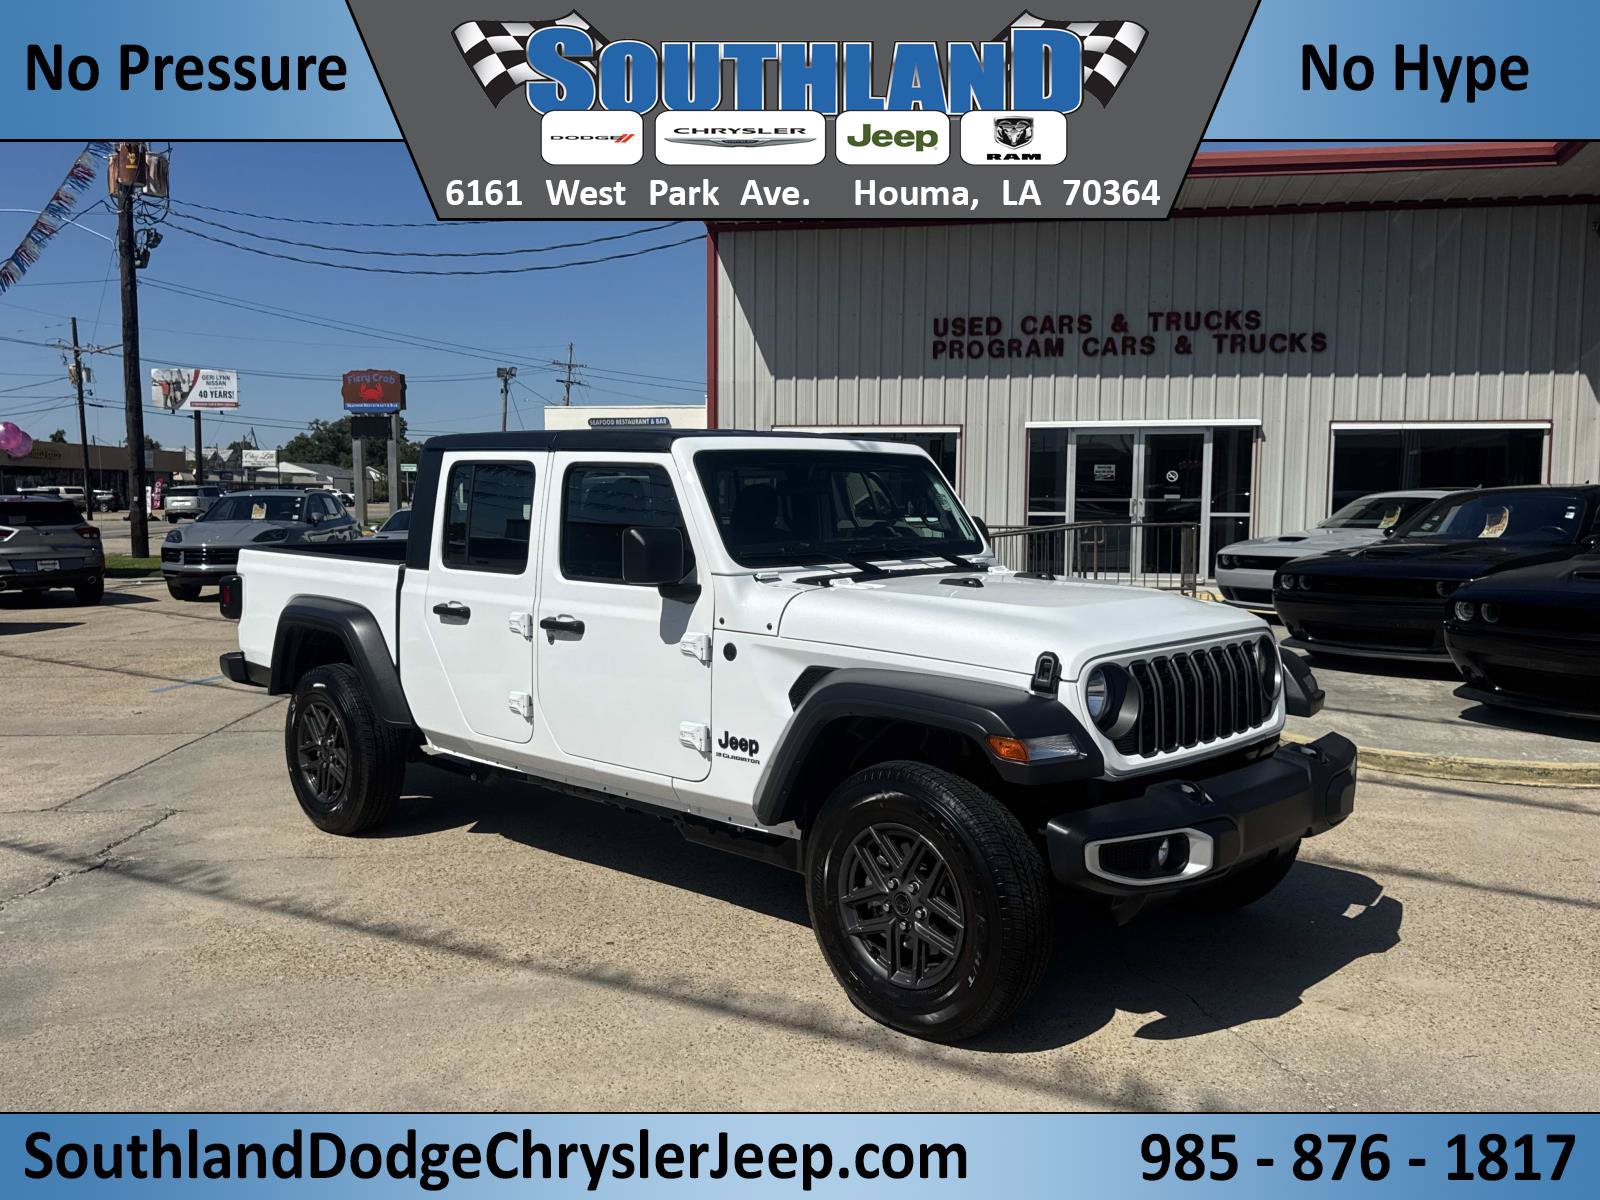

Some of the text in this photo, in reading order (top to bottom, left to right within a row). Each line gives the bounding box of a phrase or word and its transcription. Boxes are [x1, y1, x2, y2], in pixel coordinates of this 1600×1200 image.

[933, 310, 1262, 337] USED CARS & TRUCKS
[932, 332, 1327, 360] PROGRAM CARS & TRUCKS
[199, 390, 208, 399] 40
[718, 731, 760, 757] Jeep
